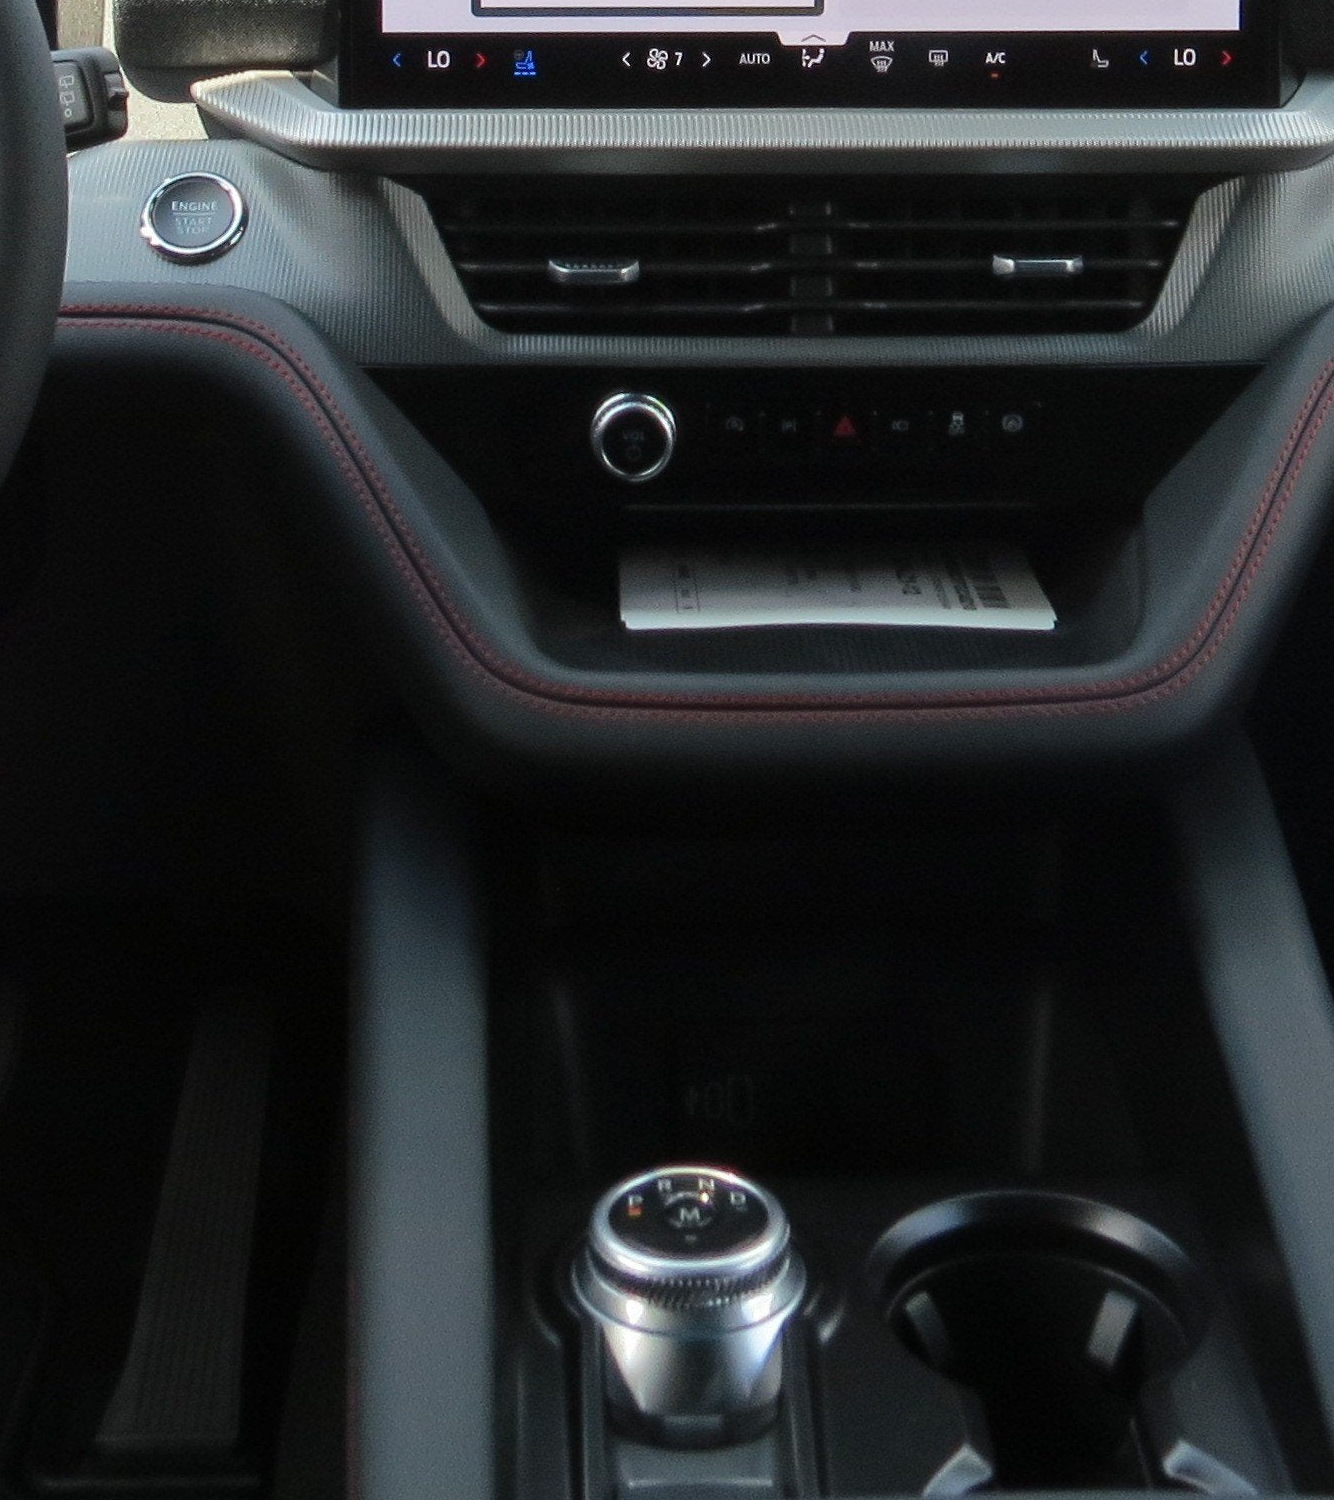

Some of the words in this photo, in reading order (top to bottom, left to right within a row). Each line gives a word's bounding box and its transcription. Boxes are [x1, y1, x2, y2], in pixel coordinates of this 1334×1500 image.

[869, 41, 895, 52] MAX
[427, 51, 451, 69] LO
[675, 52, 683, 66] 7
[739, 52, 770, 65] AUTO
[985, 51, 1006, 64] A/C
[1174, 49, 1197, 67] LO
[171, 201, 218, 211] ENGINE
[175, 217, 212, 225] START
[657, 1178, 672, 1192] R
[698, 1177, 715, 1192] N
[628, 1194, 644, 1206] P
[679, 1206, 701, 1220] M
